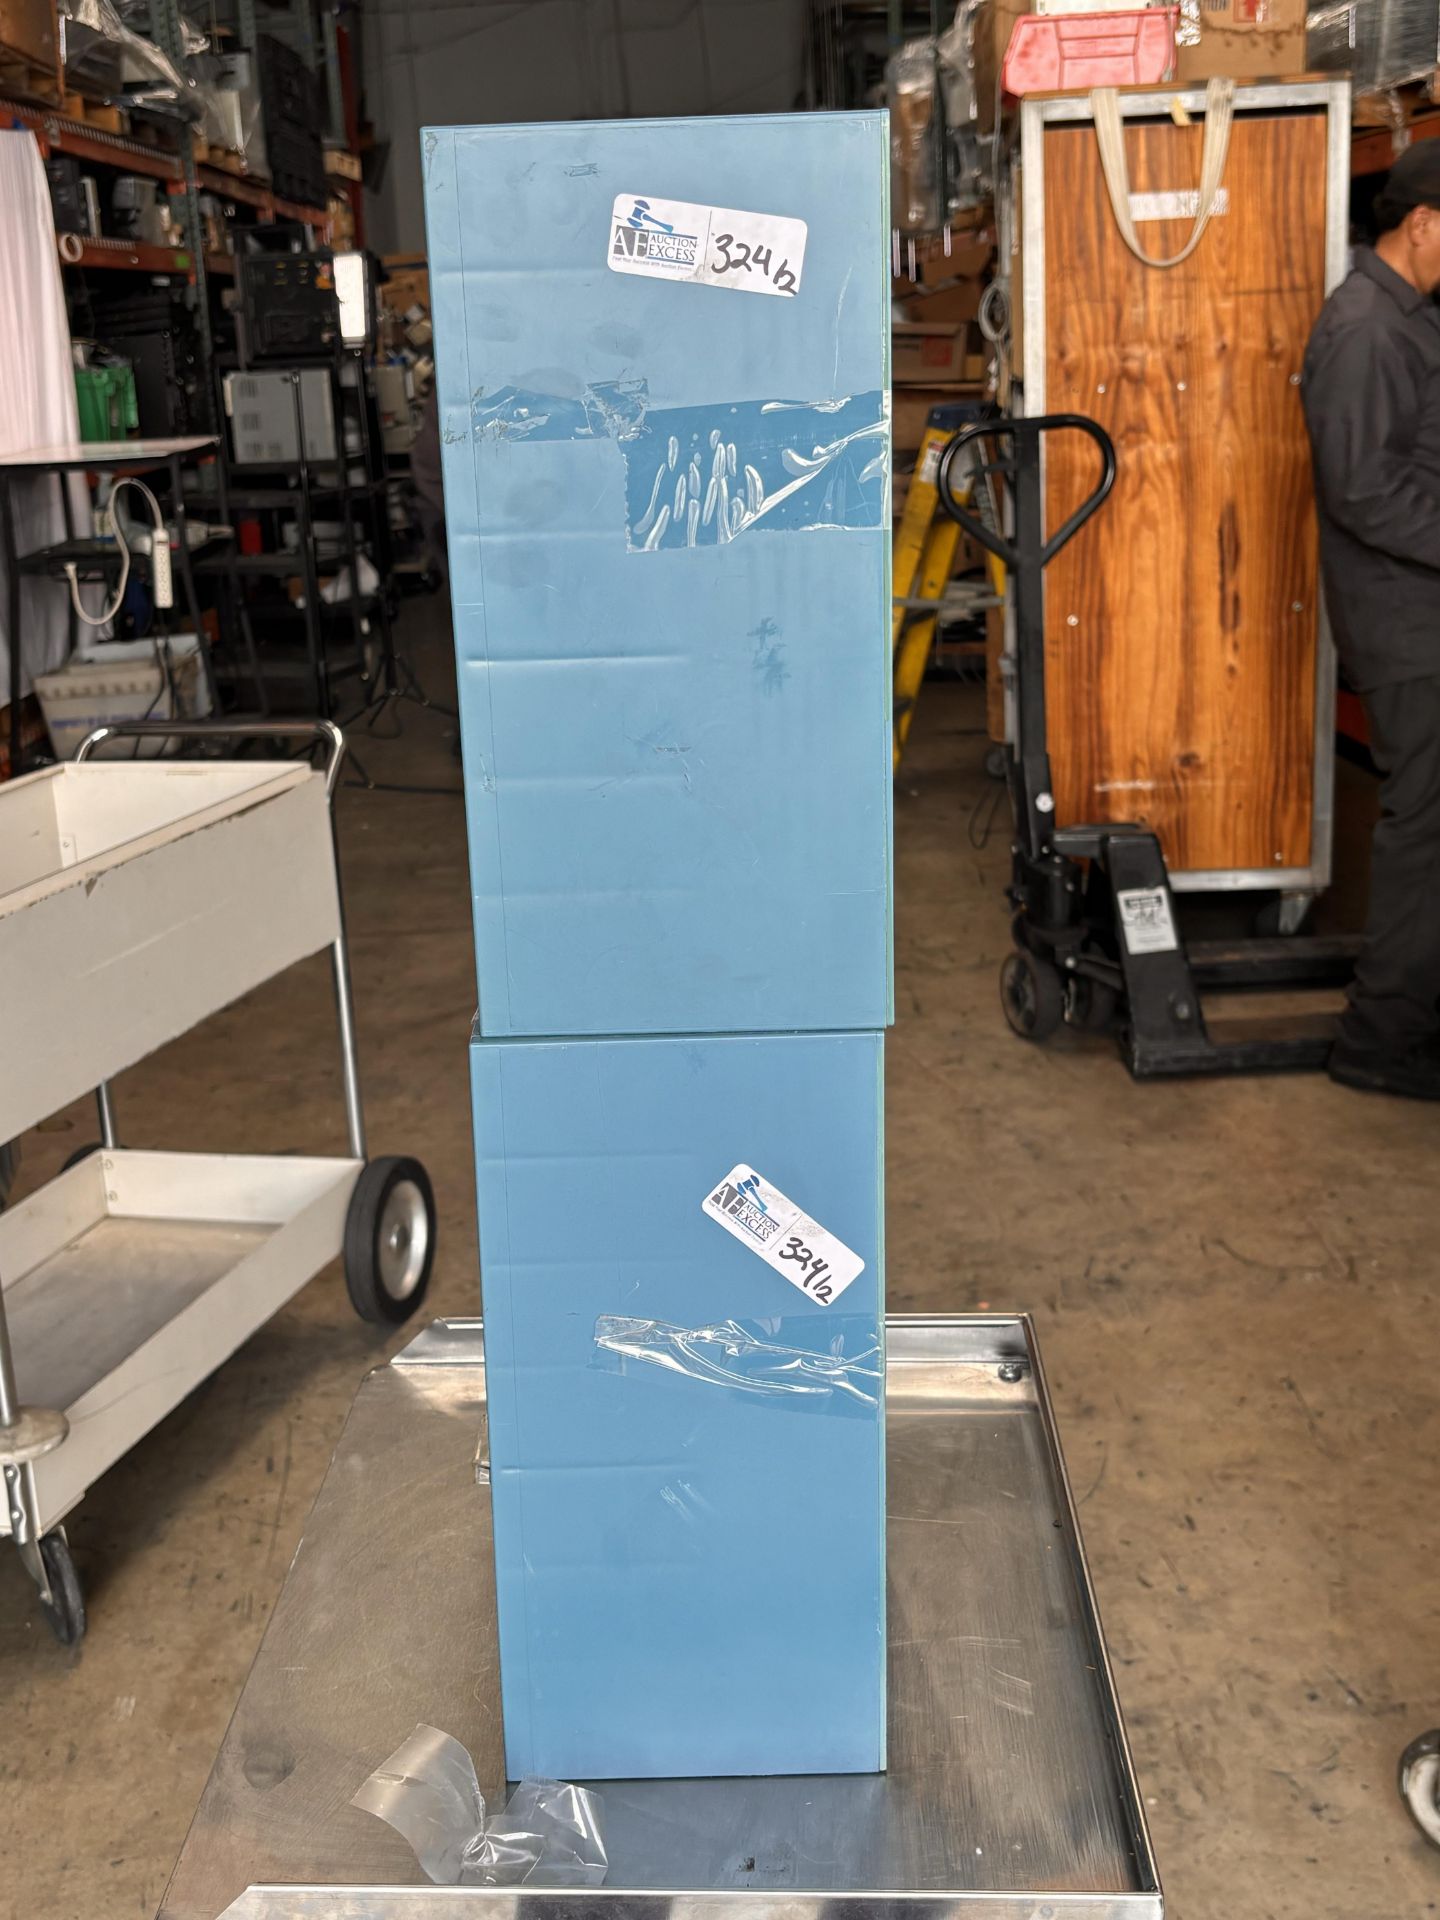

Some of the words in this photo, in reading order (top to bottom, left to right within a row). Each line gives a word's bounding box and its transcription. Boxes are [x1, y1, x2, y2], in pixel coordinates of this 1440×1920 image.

[648, 244, 696, 262] EXCESS
[649, 234, 698, 249] AUCTION
[737, 1210, 773, 1240] EXCESS
[743, 1204, 778, 1233] AUCTION
